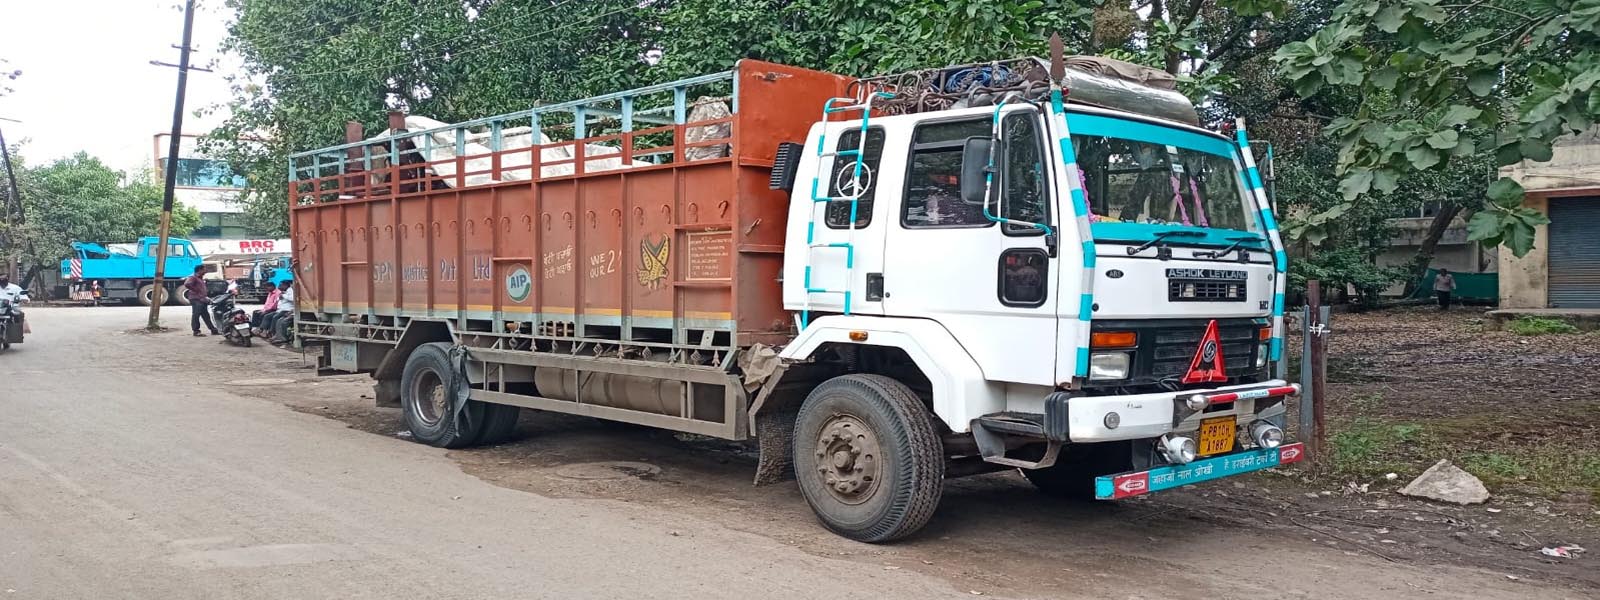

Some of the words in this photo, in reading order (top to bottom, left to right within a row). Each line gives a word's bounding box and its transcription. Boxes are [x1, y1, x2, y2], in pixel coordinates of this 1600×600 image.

[590, 253, 606, 265] WE
[440, 256, 456, 282] Pvt
[473, 255, 492, 281] Ltd
[589, 265, 606, 279] OUR
[1168, 269, 1204, 278] ASHOK
[1209, 271, 1248, 279] LEYLAND
[510, 274, 527, 288] AIP
